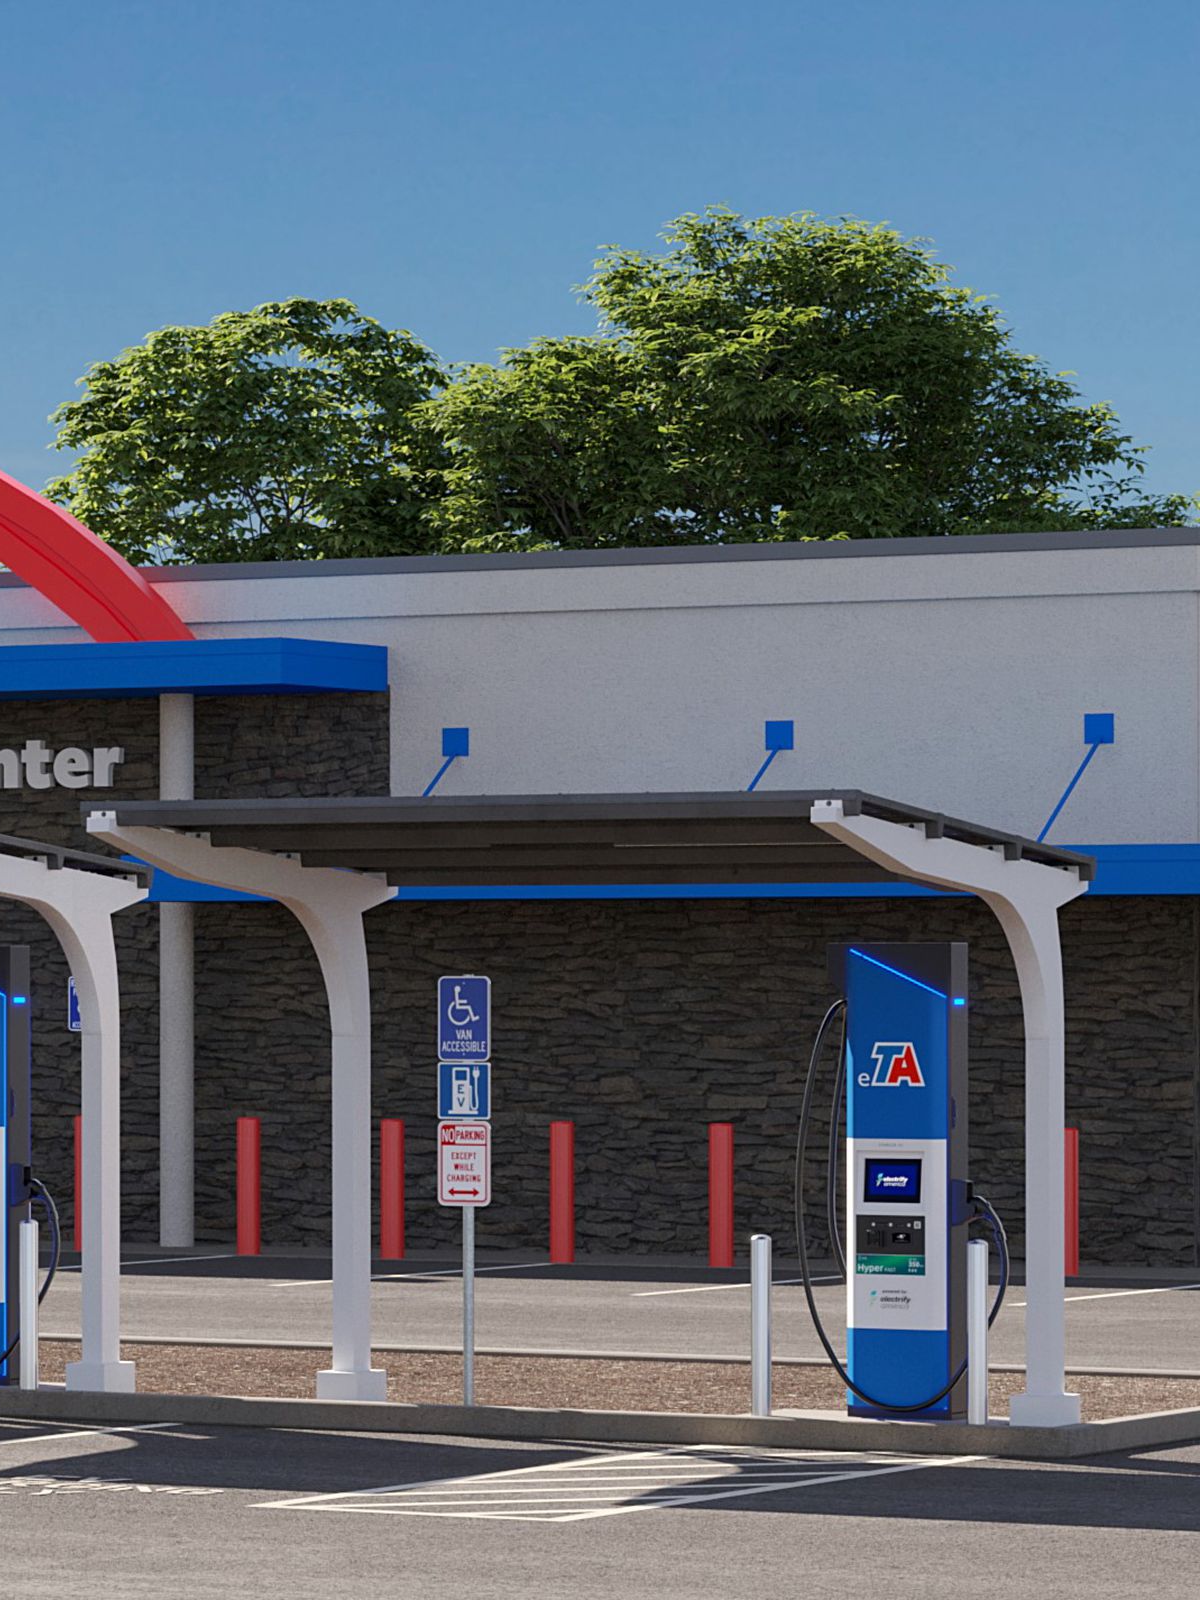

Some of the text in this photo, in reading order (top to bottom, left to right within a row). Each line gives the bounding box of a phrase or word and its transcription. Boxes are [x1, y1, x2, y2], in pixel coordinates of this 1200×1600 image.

[455, 1029, 473, 1040] VAN
[441, 1041, 487, 1053] ACCESSIBLE
[441, 1127, 486, 1143] NO PARKING
[450, 1151, 477, 1160] EXCEPT
[446, 1174, 481, 1182] CHARGING
[857, 1263, 884, 1273] Hyper
